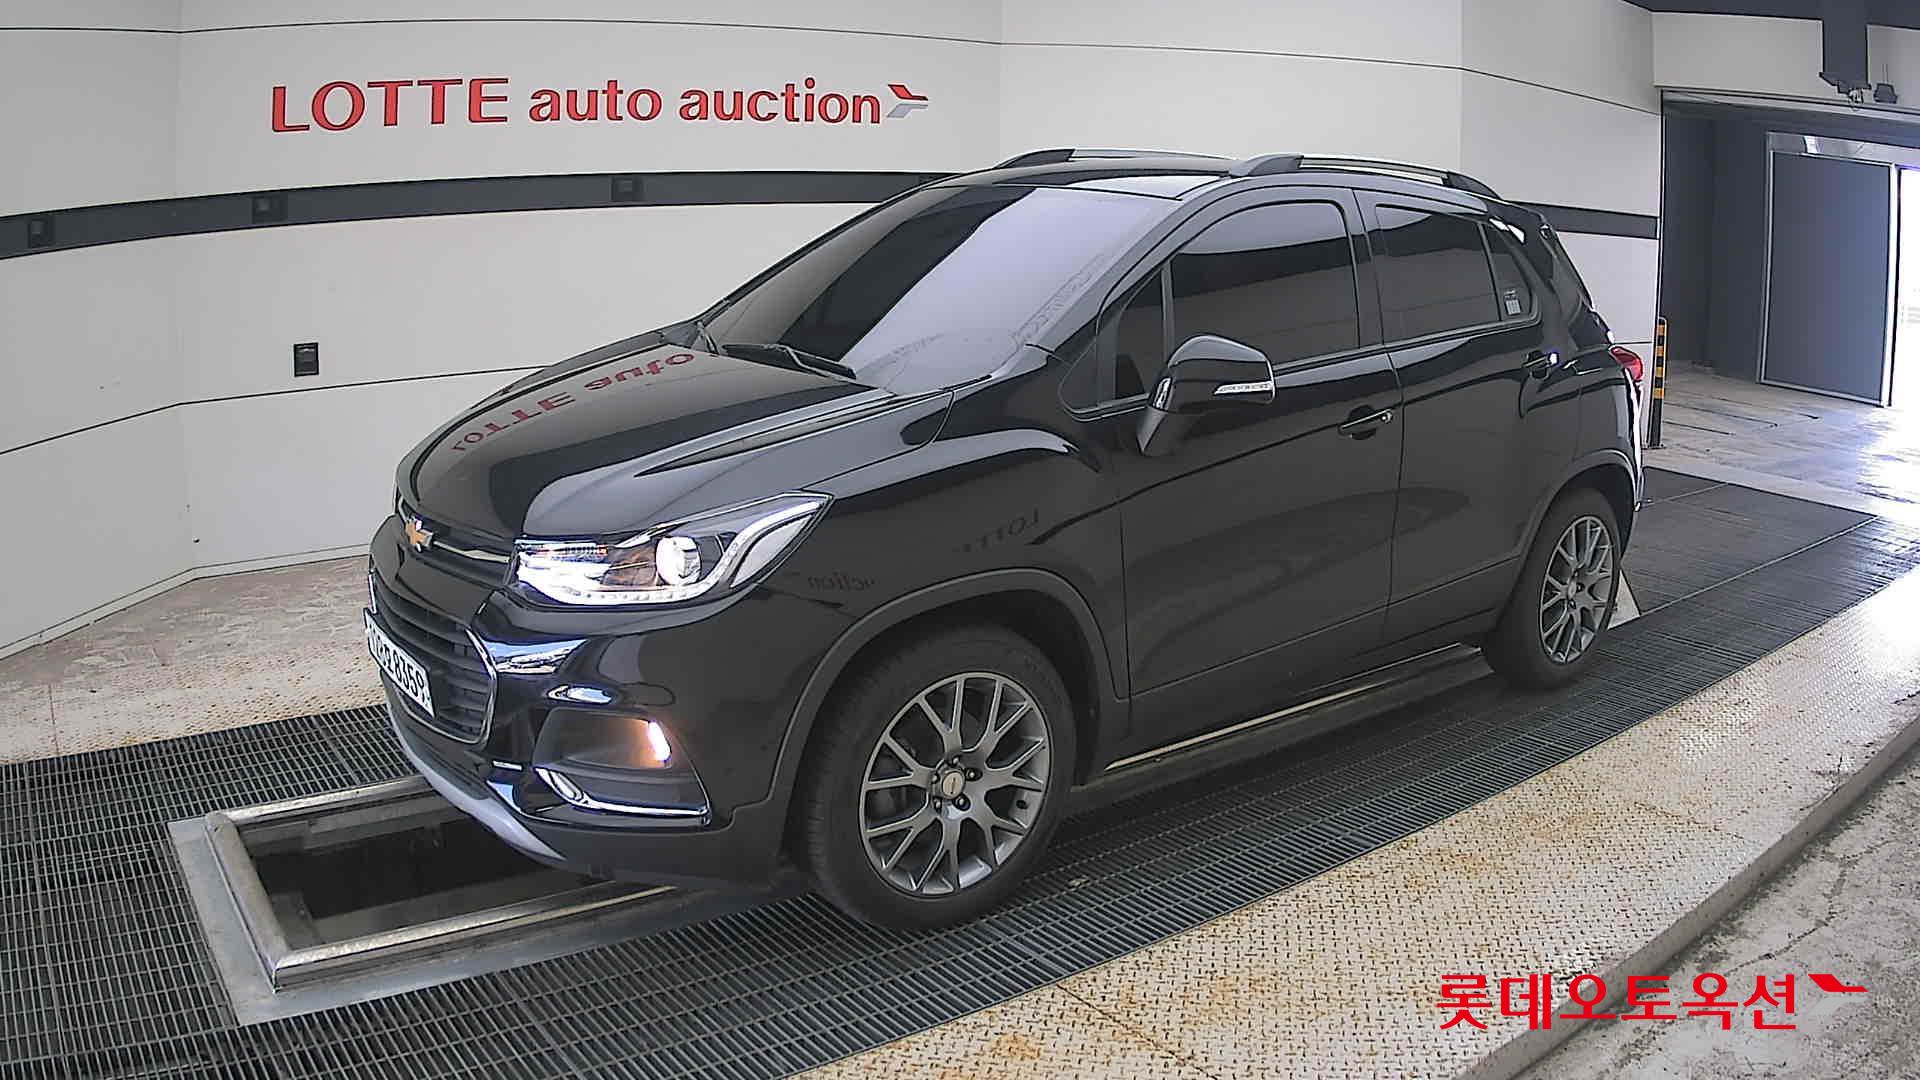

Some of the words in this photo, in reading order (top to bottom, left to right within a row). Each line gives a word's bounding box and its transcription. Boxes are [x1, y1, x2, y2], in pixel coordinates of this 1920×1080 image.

[270, 78, 508, 132] LOTTE
[528, 78, 662, 122] auto
[679, 78, 881, 124] auction
